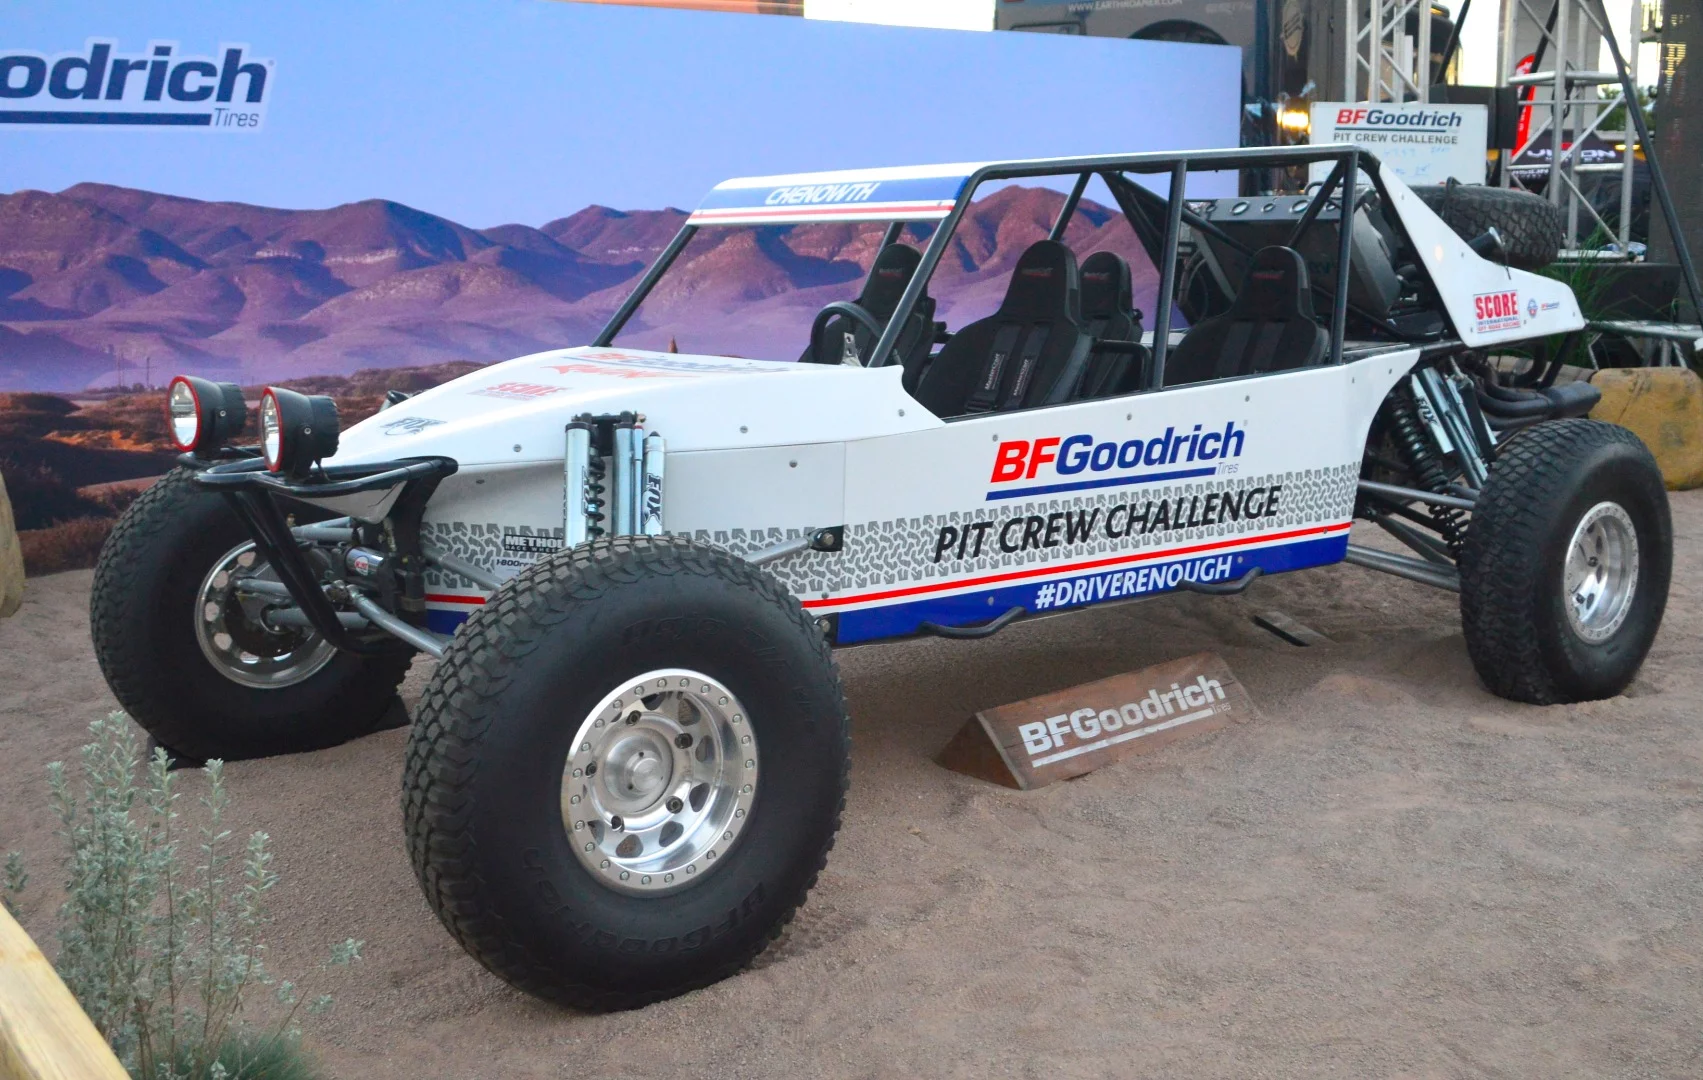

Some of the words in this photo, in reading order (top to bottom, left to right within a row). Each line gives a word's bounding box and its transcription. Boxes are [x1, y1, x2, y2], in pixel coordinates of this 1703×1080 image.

[213, 108, 259, 127] Tires
[1336, 108, 1462, 128] BFGoodrich
[1333, 133, 1351, 142] PIT
[1355, 134, 1387, 143] CREW
[1391, 135, 1458, 145] CHALLENGE
[765, 182, 881, 205] CHENOWTH
[1475, 292, 1518, 320] SCORE
[990, 420, 1245, 483] BFGoodrich
[1217, 461, 1239, 475] Tires
[643, 473, 663, 526] FOX
[933, 521, 994, 564] PIT
[1000, 507, 1100, 553] CREW
[1105, 485, 1282, 539] CHALLENGE
[1035, 556, 1233, 609] #DRIVERENOUGH
[1018, 675, 1226, 755] BFGoodrich
